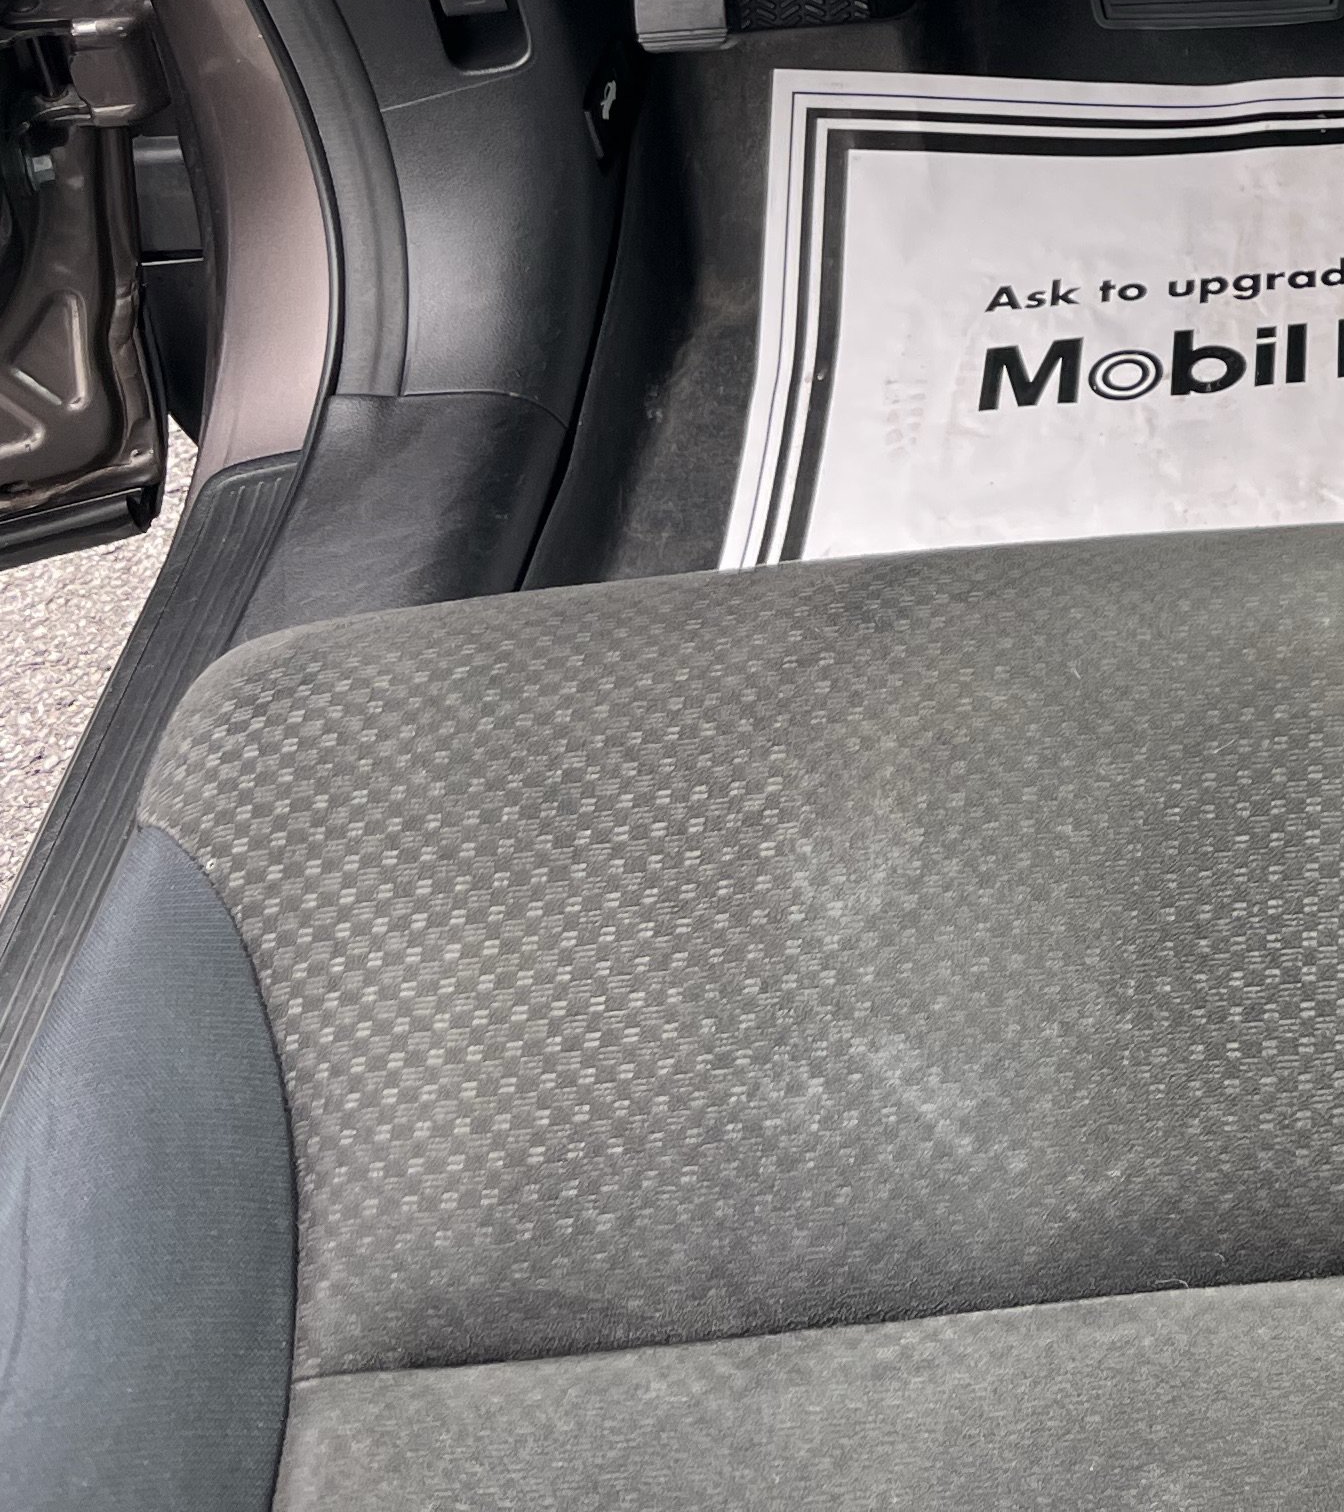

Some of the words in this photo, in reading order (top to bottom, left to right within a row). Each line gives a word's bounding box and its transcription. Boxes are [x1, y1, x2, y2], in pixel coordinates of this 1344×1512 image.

[984, 278, 1083, 313] Ask
[1099, 279, 1148, 303] to
[978, 322, 1308, 412] Mobil
